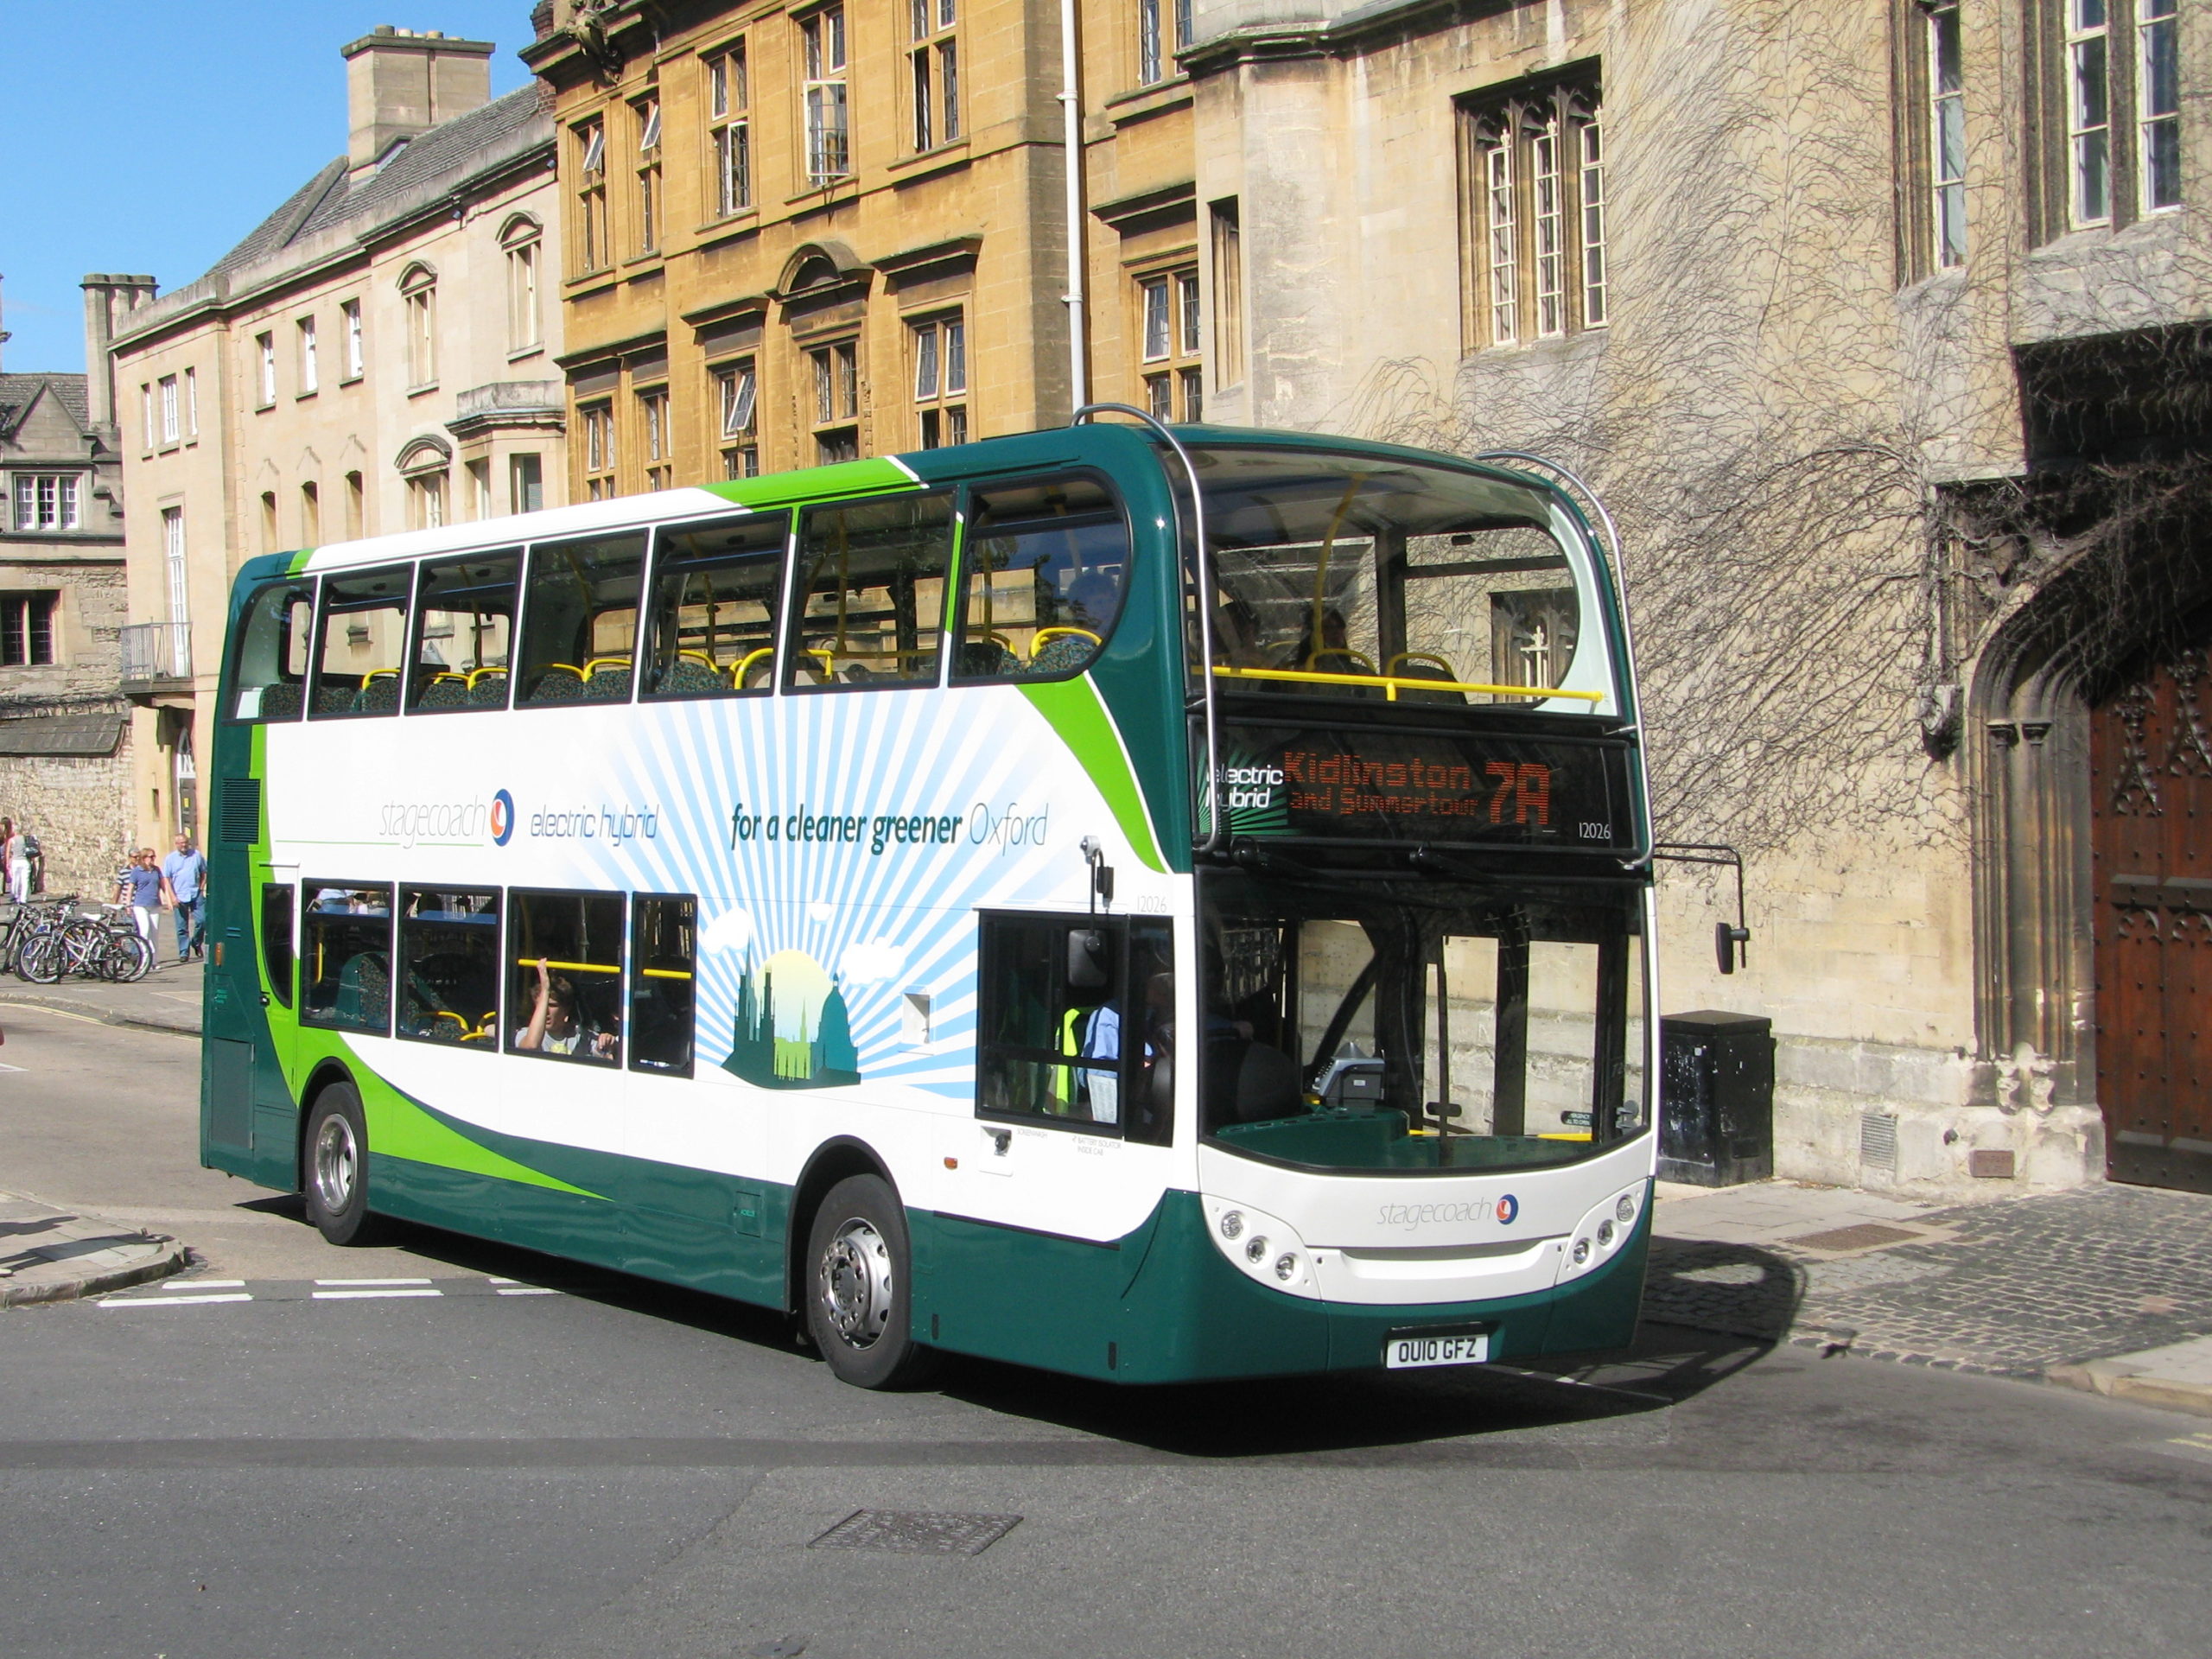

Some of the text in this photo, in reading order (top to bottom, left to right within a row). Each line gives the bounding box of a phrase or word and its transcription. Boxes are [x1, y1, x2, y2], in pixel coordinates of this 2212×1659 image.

[1290, 787, 1332, 810] and
[1485, 762, 1549, 824] 7A
[378, 795, 486, 849] stagecoach
[531, 804, 659, 847] electric hybrid
[731, 803, 1049, 856] for a cleaner greener Oxford
[1579, 822, 1611, 840] 12026
[1137, 895, 1167, 913] 12026
[1376, 1197, 1493, 1230] stagecoach
[1443, 1338, 1477, 1360] GFZ
